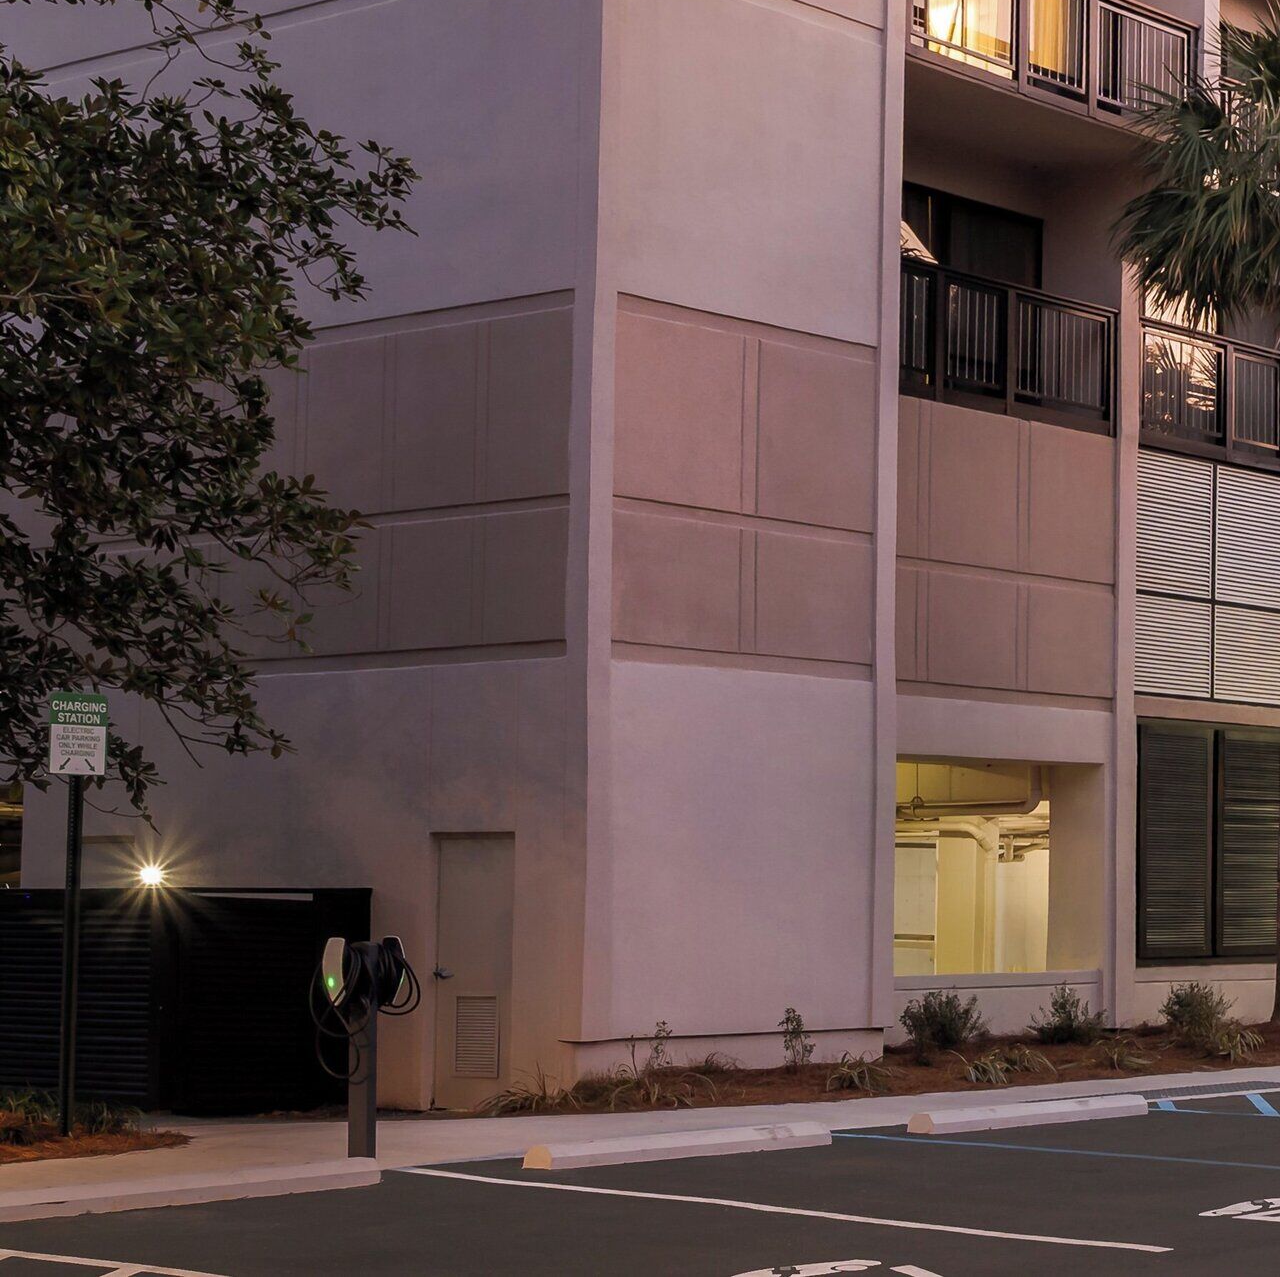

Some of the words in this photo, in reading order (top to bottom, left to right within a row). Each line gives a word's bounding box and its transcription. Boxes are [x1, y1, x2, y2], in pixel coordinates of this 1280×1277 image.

[52, 700, 107, 713] CHARGING
[58, 712, 100, 724] STATION
[60, 749, 96, 757] CHARGING
